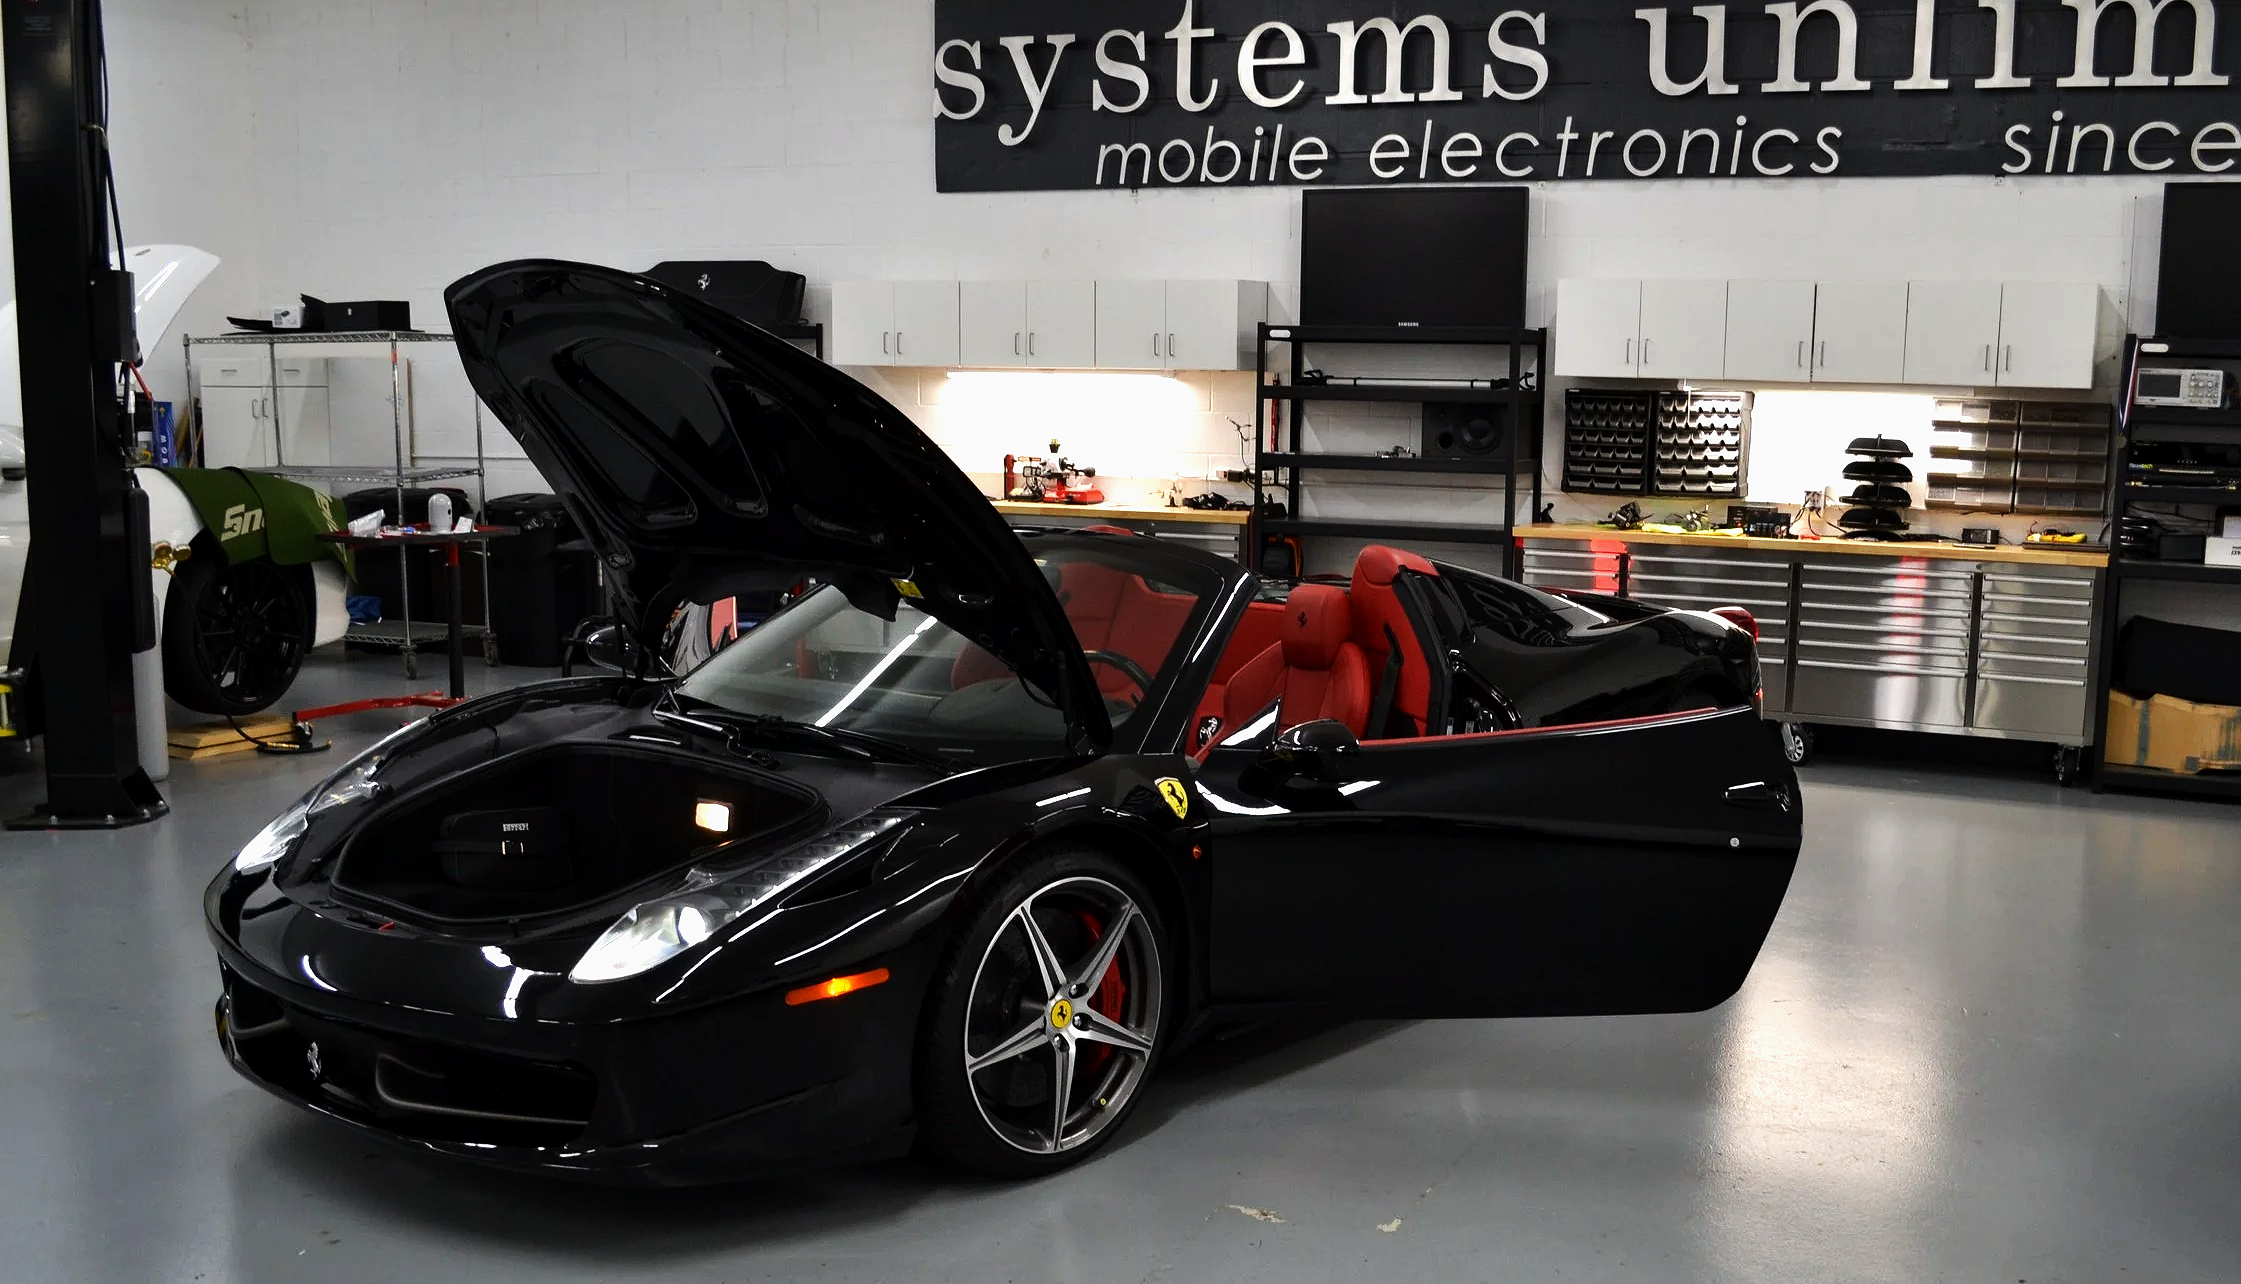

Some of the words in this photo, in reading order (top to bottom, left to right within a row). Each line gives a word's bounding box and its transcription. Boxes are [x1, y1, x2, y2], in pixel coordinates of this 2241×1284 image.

[935, 0, 1548, 146] systems
[1096, 124, 1329, 185] mobile
[1369, 115, 1842, 179] electronics
[2001, 110, 2241, 173] since
